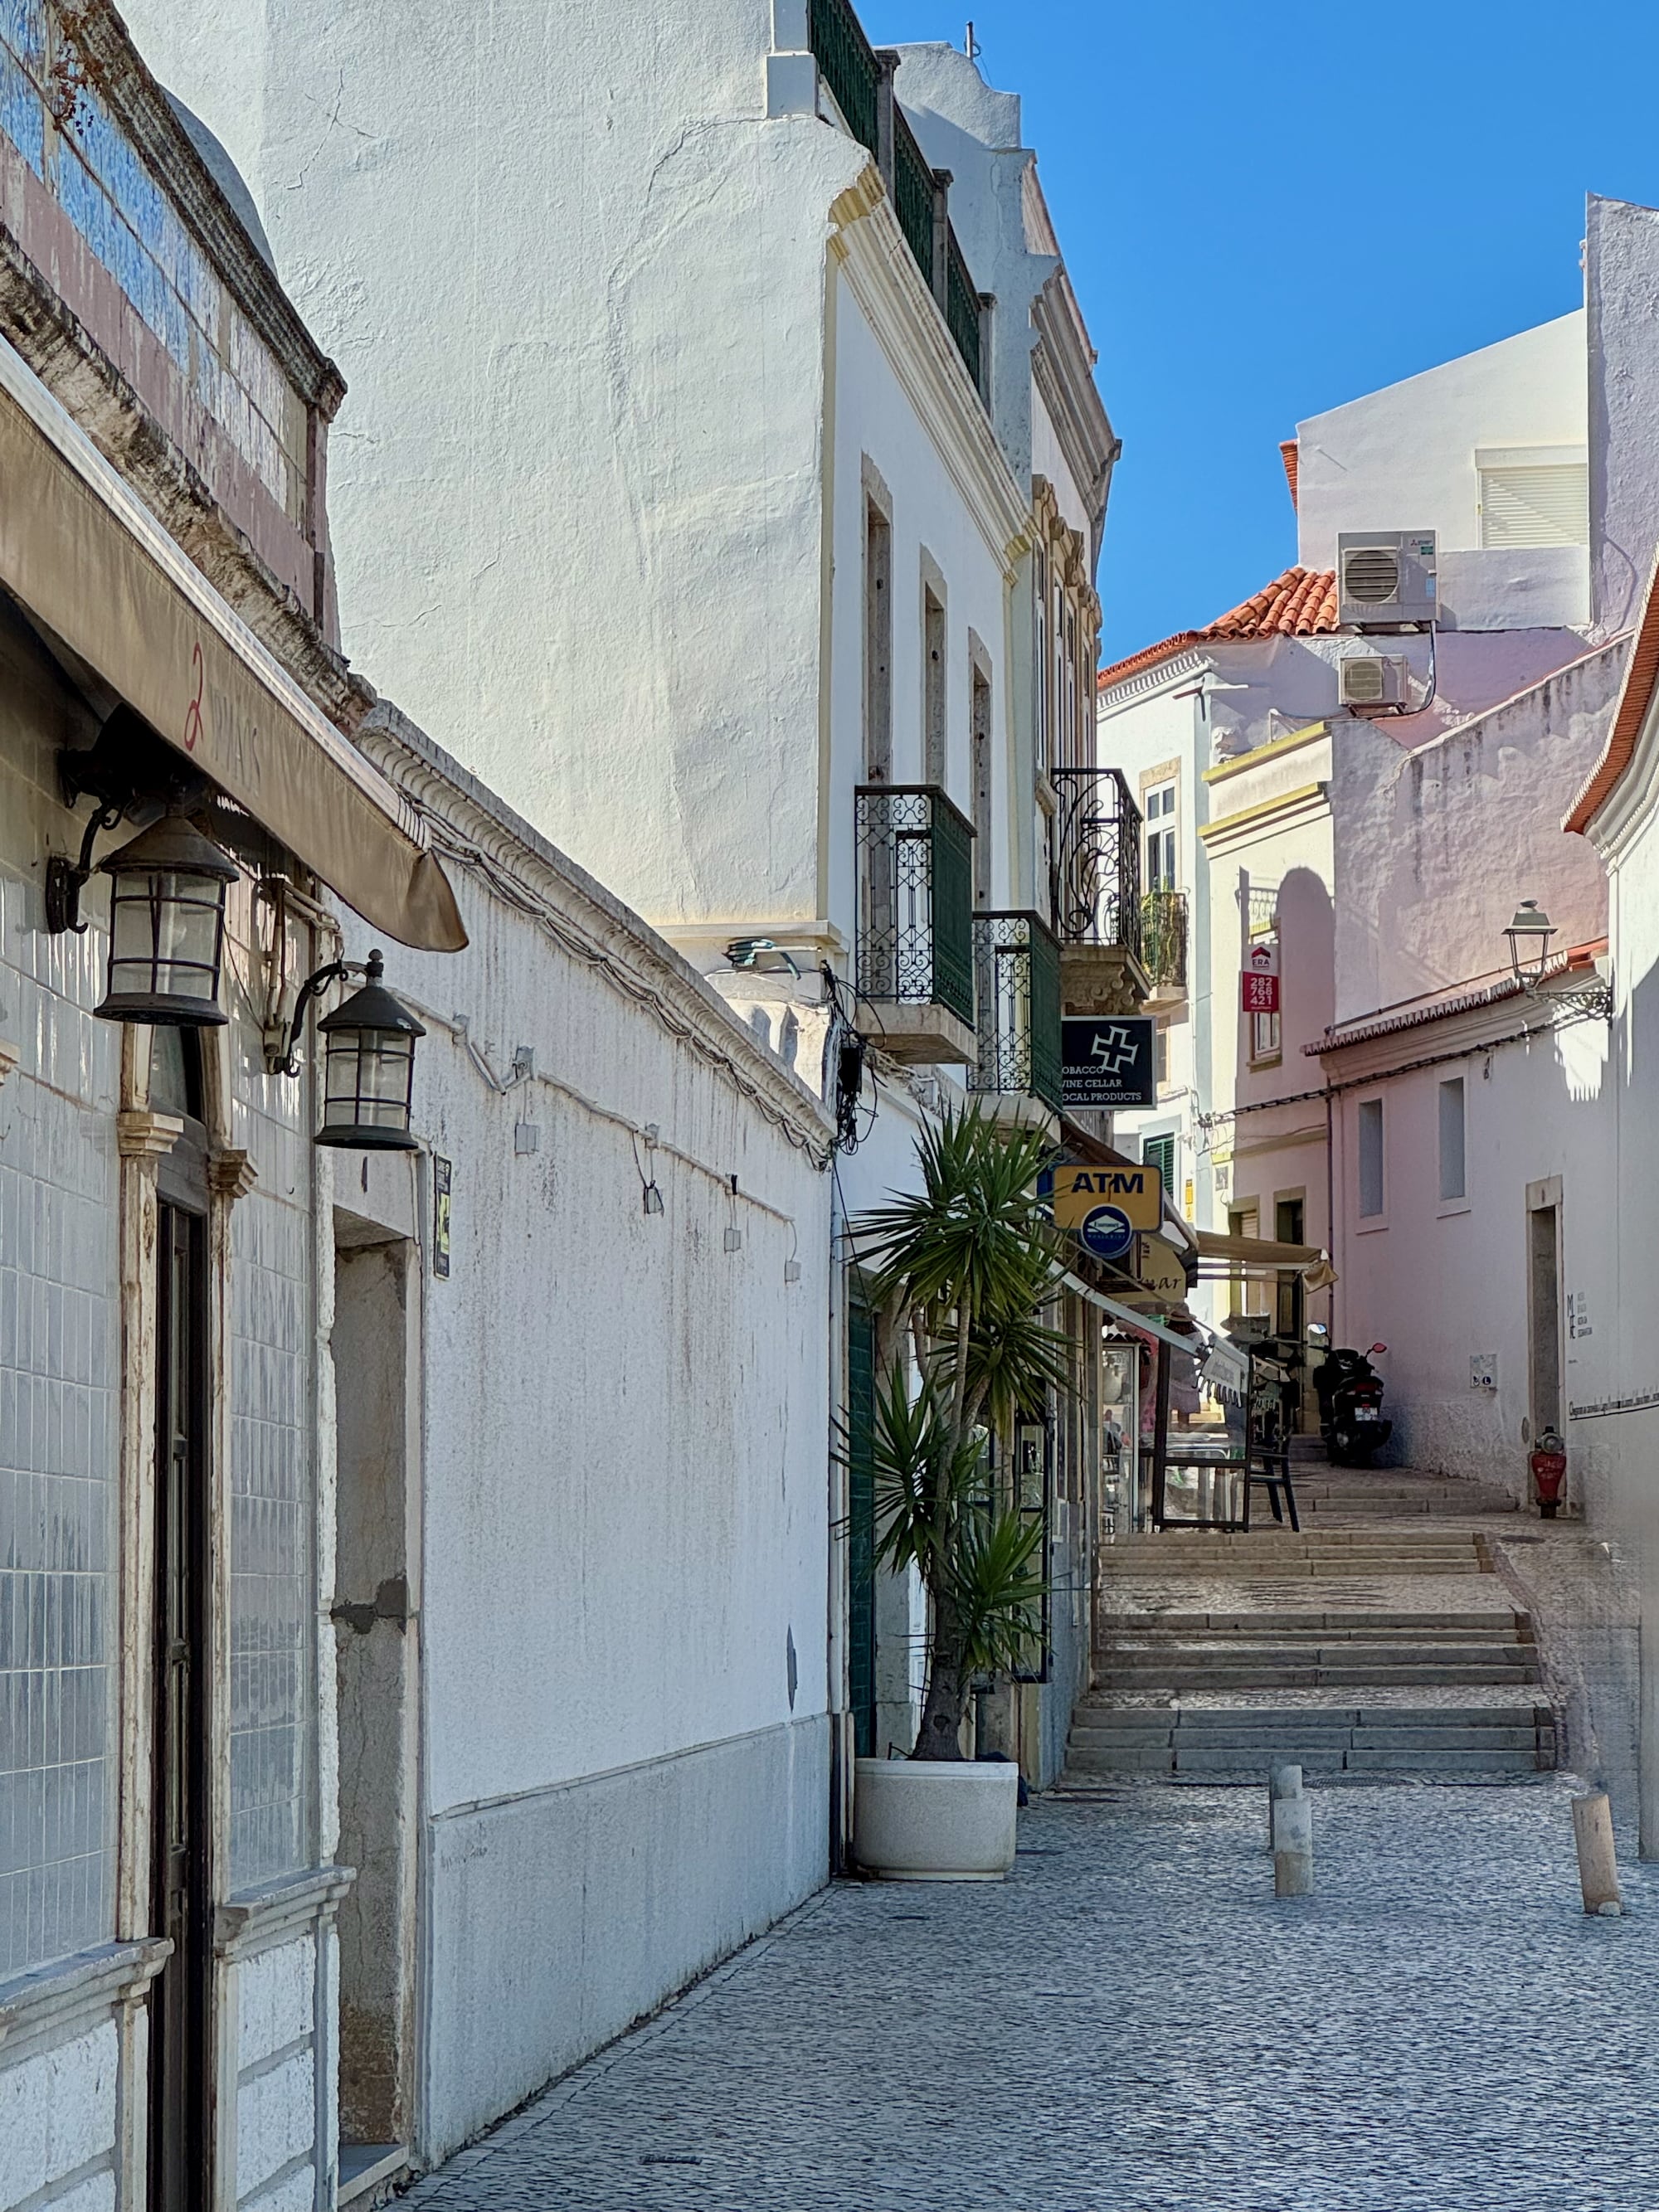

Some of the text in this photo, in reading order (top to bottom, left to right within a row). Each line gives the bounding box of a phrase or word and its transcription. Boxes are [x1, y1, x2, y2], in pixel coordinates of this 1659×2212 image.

[1250, 977, 1272, 986] 282
[1250, 987, 1273, 996] 768
[1249, 996, 1272, 1005] 421
[1062, 1066, 1105, 1074] OBACCO
[1084, 1079, 1122, 1088] CELLAR
[1062, 1092, 1142, 1101] OCAL PRODUCTS
[1072, 1173, 1144, 1194] ATM
